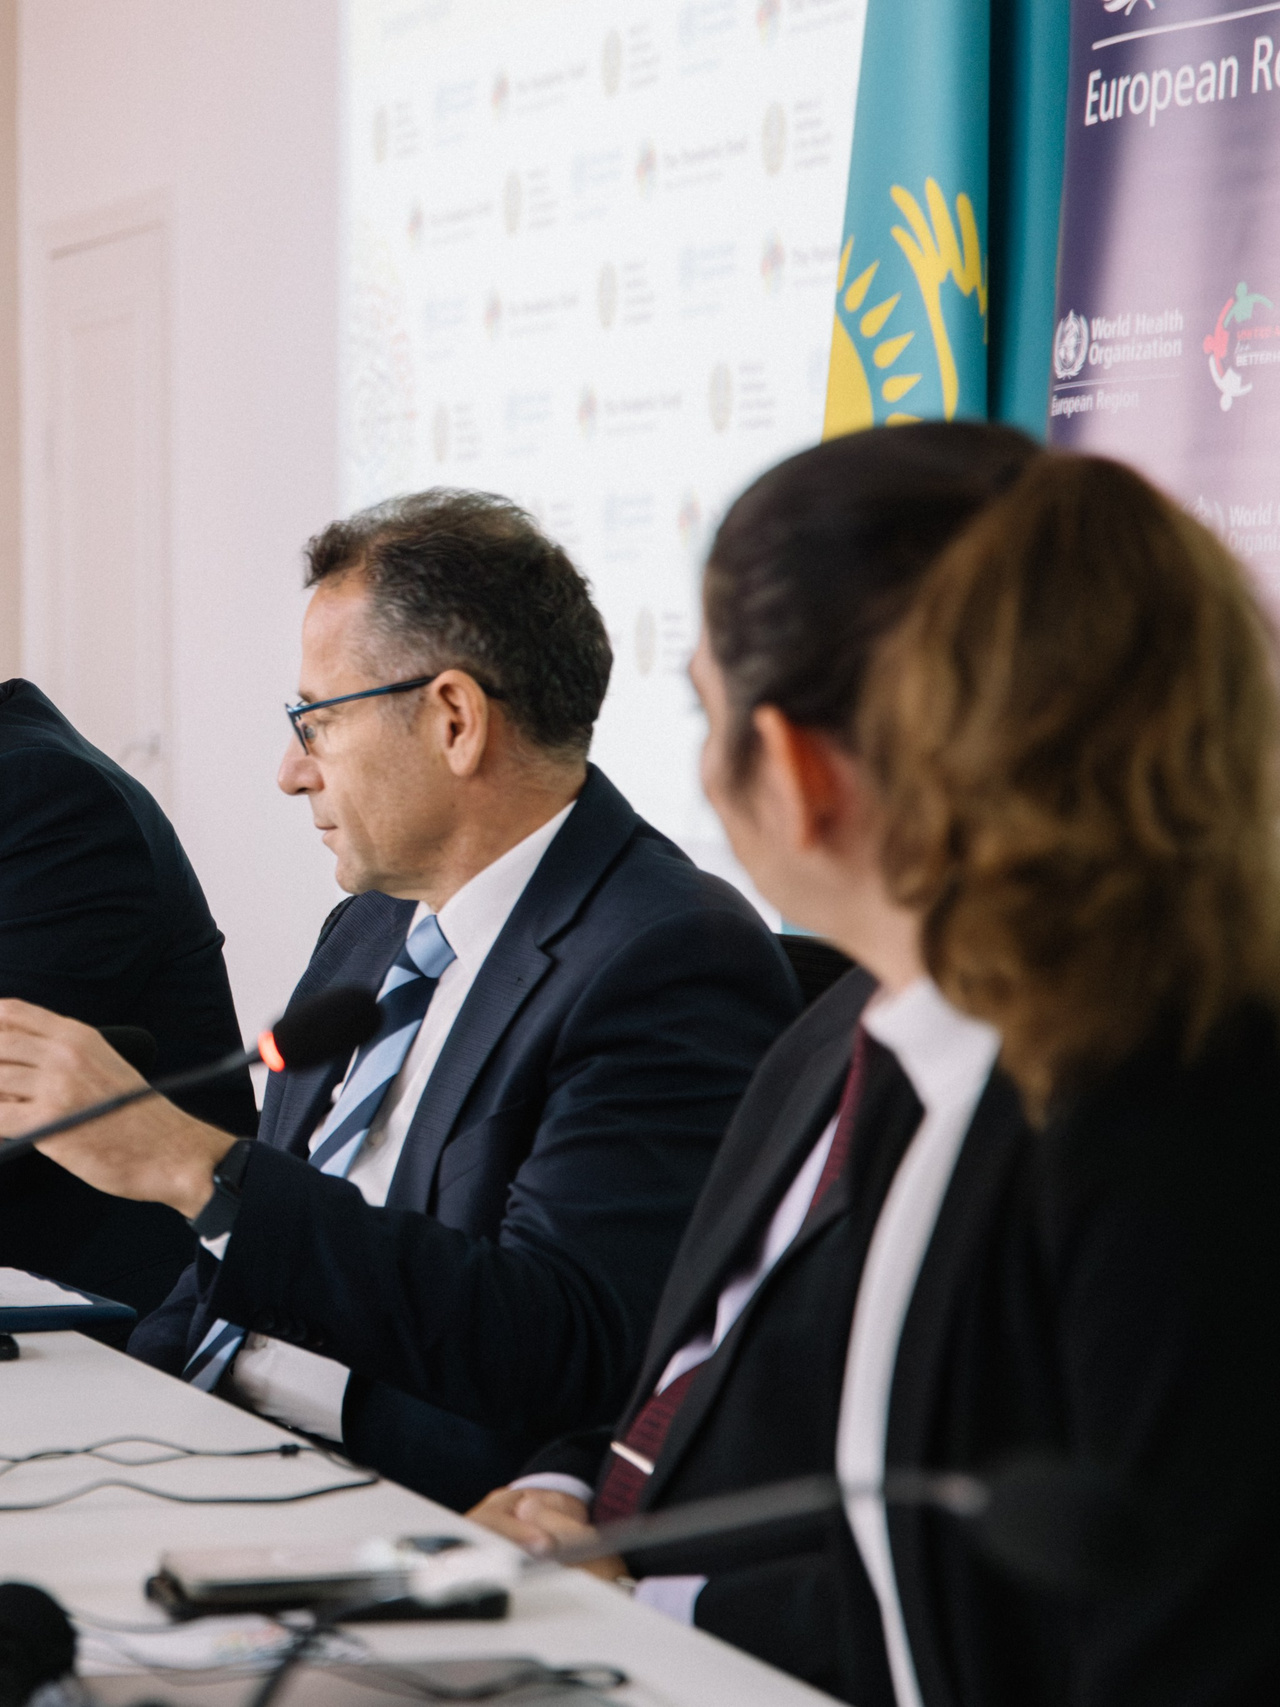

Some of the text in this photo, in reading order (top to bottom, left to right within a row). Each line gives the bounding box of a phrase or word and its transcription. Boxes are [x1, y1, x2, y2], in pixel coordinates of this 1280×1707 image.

[1084, 35, 1280, 128] European R
[1092, 308, 1183, 340] World Health
[1089, 338, 1182, 369] Organization
[1051, 388, 1140, 418] European Region
[1229, 501, 1273, 528] World
